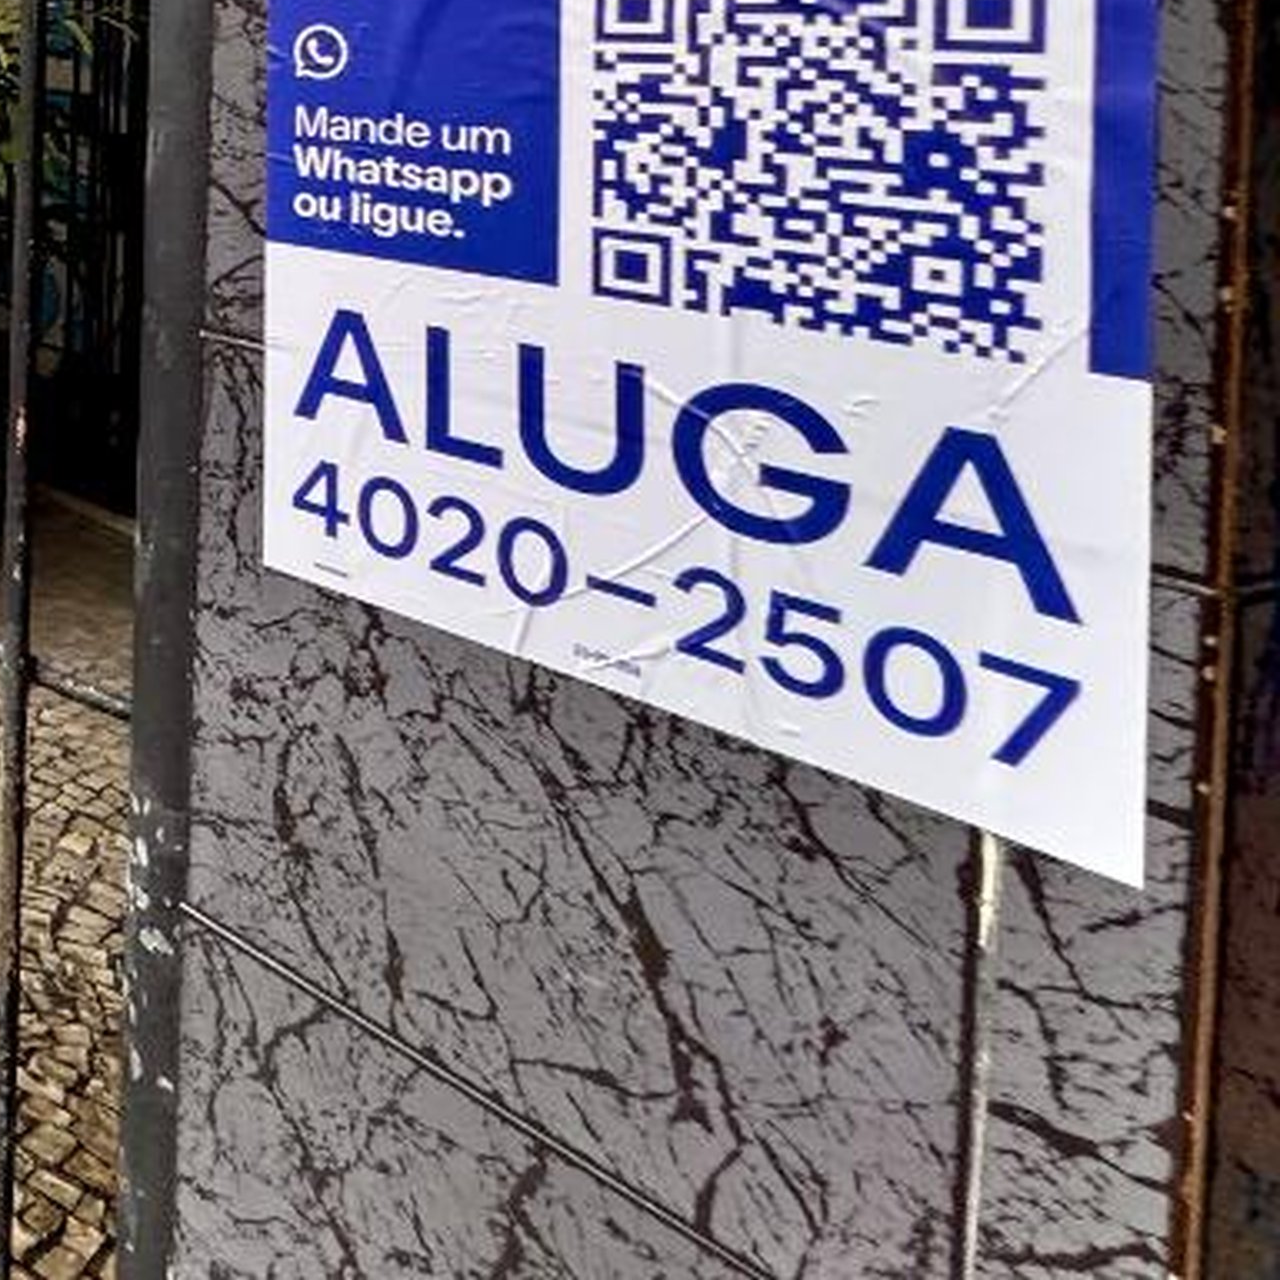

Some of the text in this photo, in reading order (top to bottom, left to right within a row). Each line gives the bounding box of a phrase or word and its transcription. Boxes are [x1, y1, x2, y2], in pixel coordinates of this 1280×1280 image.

[294, 104, 512, 156] Mande um
[292, 143, 514, 208] Whatsapp
[292, 190, 466, 239] ou ligue.
[293, 308, 1085, 626] ALUGA
[291, 459, 1083, 769] 4020-2507
